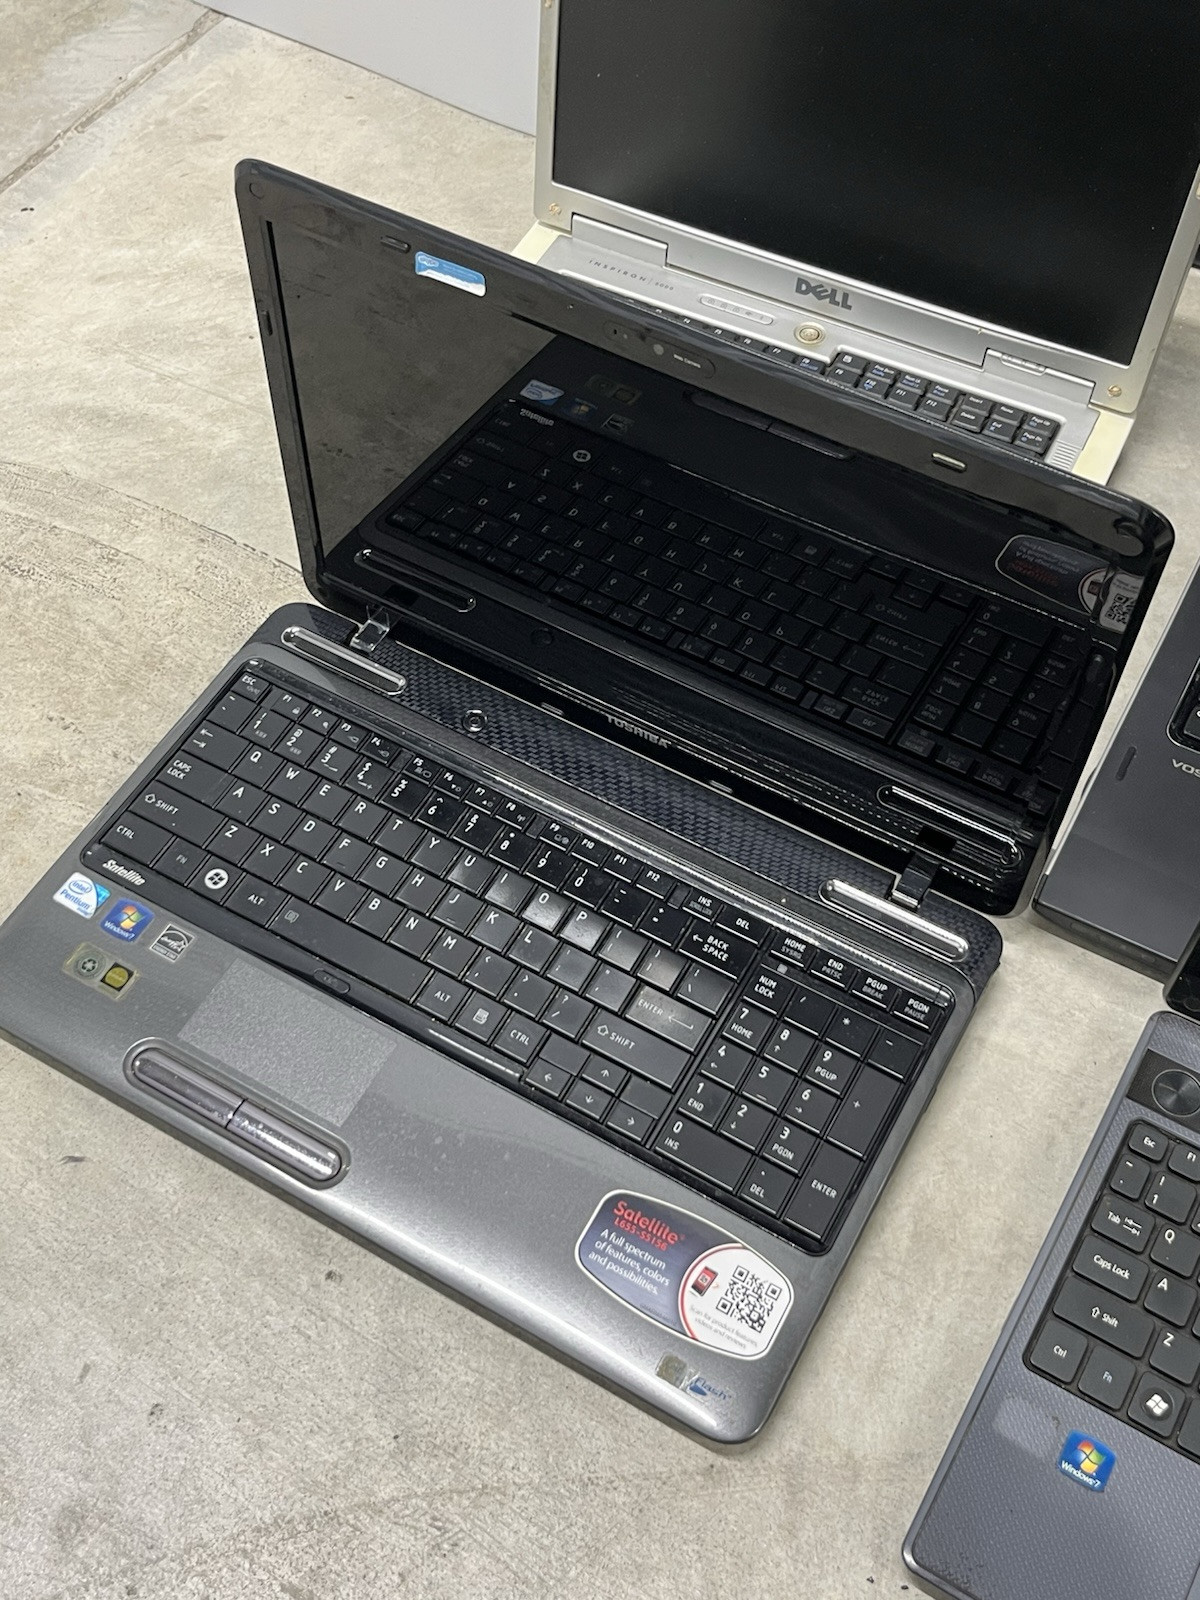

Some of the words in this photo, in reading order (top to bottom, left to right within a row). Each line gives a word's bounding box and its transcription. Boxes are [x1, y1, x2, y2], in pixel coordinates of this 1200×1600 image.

[589, 259, 647, 281] INSPIRON
[795, 277, 852, 311] DELL
[242, 675, 256, 685] ESC
[312, 709, 322, 717] F2
[254, 720, 261, 729] 1
[341, 723, 351, 731] F3
[287, 737, 296, 746] 2
[371, 737, 381, 746] F4
[250, 751, 261, 763] Q
[321, 754, 330, 762] 3
[414, 758, 424, 767] F5
[173, 759, 192, 772] CAPS
[167, 766, 186, 780] LOCK
[286, 768, 299, 780] W
[357, 771, 364, 780] 4
[444, 773, 454, 781] F6
[233, 786, 244, 798] A
[319, 785, 331, 796] E
[392, 788, 400, 797] 5
[476, 787, 485, 796] F7
[155, 800, 178, 815] SHIFT
[268, 804, 280, 814] S
[355, 803, 366, 814] R
[428, 806, 436, 815] 6
[506, 803, 516, 811] F8
[303, 821, 315, 832] D
[392, 820, 403, 831] T
[465, 822, 474, 832] 7
[550, 823, 560, 832] F9
[116, 825, 135, 839] CTRL
[225, 826, 238, 838] Z
[260, 843, 275, 856] X
[339, 839, 351, 849] F
[430, 838, 440, 849] Y
[501, 840, 509, 850] 8
[582, 839, 595, 849] F10
[376, 857, 388, 868] G
[465, 857, 476, 867] U
[538, 858, 546, 868] 9
[614, 855, 627, 865] F11
[102, 858, 146, 886] Satellite
[296, 862, 308, 873] C
[412, 874, 424, 886] H
[500, 874, 508, 884] I
[575, 877, 583, 887] 0
[646, 871, 660, 881] F12
[334, 880, 345, 891] V
[60, 889, 91, 910] Pentium
[248, 894, 264, 906] ALT
[369, 898, 380, 910] B
[449, 894, 461, 904] J
[539, 893, 549, 904] O
[698, 896, 712, 907] INS
[486, 911, 499, 924] K
[576, 911, 588, 922] P
[406, 917, 419, 930] N
[736, 918, 749, 930] DEL
[443, 936, 457, 950] M
[524, 931, 532, 944] L
[707, 936, 729, 951] BACK
[784, 938, 806, 952] HOME
[702, 944, 729, 961] SPACE
[828, 959, 843, 971] END
[759, 975, 777, 989] NUM
[866, 977, 888, 991] PGUP
[434, 991, 451, 1002] ALT
[754, 985, 775, 999] LOCK
[638, 998, 664, 1016] ENTER
[908, 998, 930, 1013] PGDN
[740, 1008, 750, 1019] 7
[904, 1006, 925, 1020] PAUSE
[731, 1023, 753, 1039] HOME
[780, 1029, 790, 1040] 8
[510, 1030, 530, 1045] CTRL
[609, 1032, 635, 1049] SHIFT
[717, 1045, 727, 1057] 4
[823, 1050, 833, 1061] 9
[758, 1066, 770, 1078] 5
[815, 1066, 837, 1082] PGUP
[696, 1082, 704, 1093] 1
[802, 1089, 811, 1100] 6
[687, 1098, 704, 1111] END
[737, 1105, 748, 1117] 2
[673, 1121, 683, 1133] 0
[779, 1127, 790, 1139] 3
[664, 1137, 680, 1150] INS
[1144, 1136, 1156, 1148] Esc
[772, 1142, 795, 1160] PGDN
[1187, 1152, 1196, 1162] F1
[750, 1183, 765, 1198] DEL
[811, 1179, 837, 1198] ENTER
[1152, 1194, 1158, 1204] 1
[613, 1200, 678, 1245] Satellite
[1108, 1211, 1120, 1224] Tab
[614, 1217, 668, 1251] L655-S5156
[1164, 1229, 1175, 1244] Q
[600, 1228, 608, 1239] A
[609, 1232, 625, 1247] full
[624, 1242, 666, 1271] spectrum
[595, 1240, 607, 1251] of
[605, 1244, 641, 1272] features,
[642, 1267, 671, 1286] colors
[1094, 1254, 1112, 1270] Caps
[1112, 1264, 1130, 1280] Lock
[588, 1251, 608, 1266] and
[606, 1260, 658, 1295] possibilities.
[1157, 1278, 1168, 1291] A
[1102, 1312, 1119, 1328] Shift
[1163, 1332, 1174, 1347] Z
[1053, 1344, 1067, 1358] Ctrl
[1102, 1371, 1113, 1383] Fn
[1062, 1460, 1094, 1486] Windows
